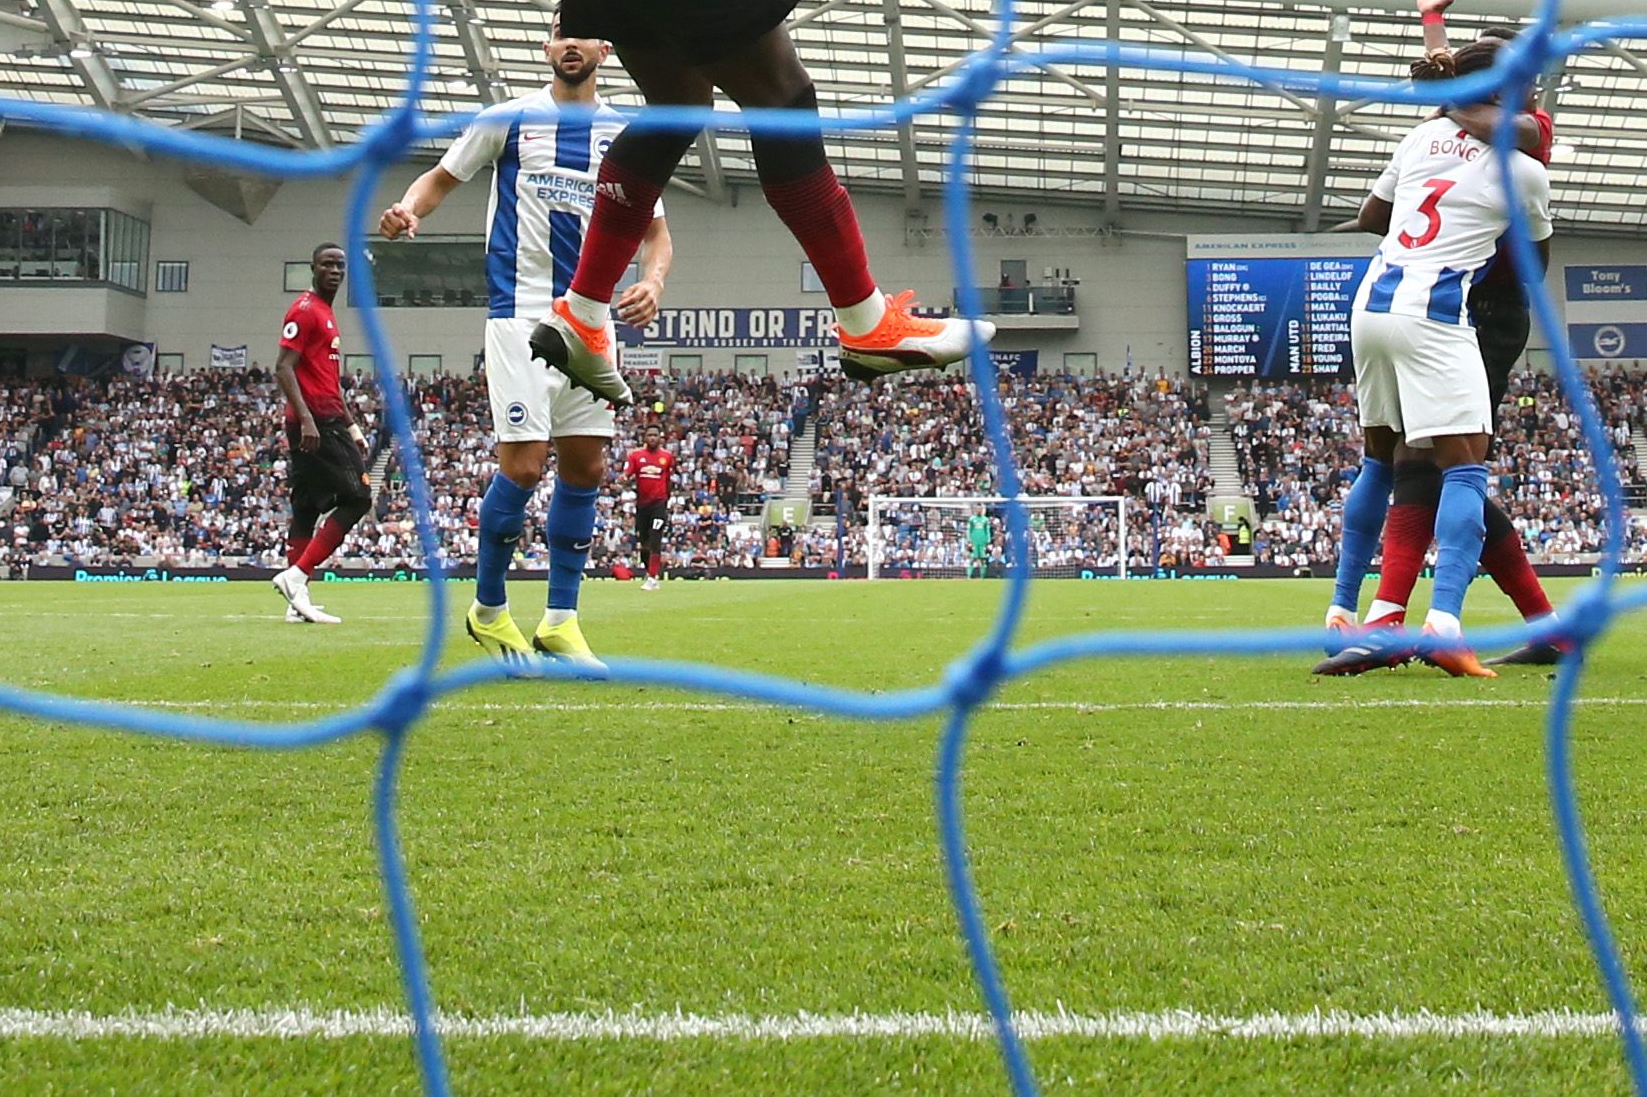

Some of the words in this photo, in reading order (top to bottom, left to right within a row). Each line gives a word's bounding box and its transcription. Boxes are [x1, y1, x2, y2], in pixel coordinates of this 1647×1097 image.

[1430, 140, 1479, 162] BONG
[1398, 178, 1457, 250] 3
[1212, 263, 1236, 271] RYAN
[1310, 262, 1322, 270] DE
[1323, 262, 1341, 270] GEA
[1212, 273, 1237, 281] BONG
[1310, 272, 1353, 280] LINDELOF
[1590, 270, 1621, 282] Tony
[1212, 283, 1241, 292] DUFFY
[1310, 282, 1341, 291] BAILLY
[1582, 284, 1632, 294] Bloom's
[1213, 293, 1258, 302] STEPHENS
[1311, 292, 1341, 301] POGBA
[1213, 304, 1266, 312] KNOCKAERT
[1311, 303, 1336, 311] MATA
[1213, 314, 1242, 322] GROSS
[1311, 313, 1347, 322] LUKAKU
[643, 310, 735, 338] STAND
[749, 310, 784, 338] OR
[1213, 324, 1255, 333] BALOGUN
[1312, 323, 1350, 332] MARTIAL
[1289, 320, 1300, 343] UTD
[1213, 334, 1250, 343] MURRAY
[1312, 334, 1349, 342] PEREIRA
[1190, 330, 1202, 374] ALBION
[1214, 345, 1246, 353] MARCH
[1312, 344, 1336, 352] FRED
[1214, 355, 1257, 364] MONTOYA
[1289, 346, 1300, 373] MAN
[1313, 354, 1343, 363] YOUNG
[1214, 365, 1256, 375] PROPPER
[1313, 364, 1339, 373] SHAW
[783, 507, 794, 523] E
[1223, 505, 1236, 521] F
[652, 519, 664, 530] 17
